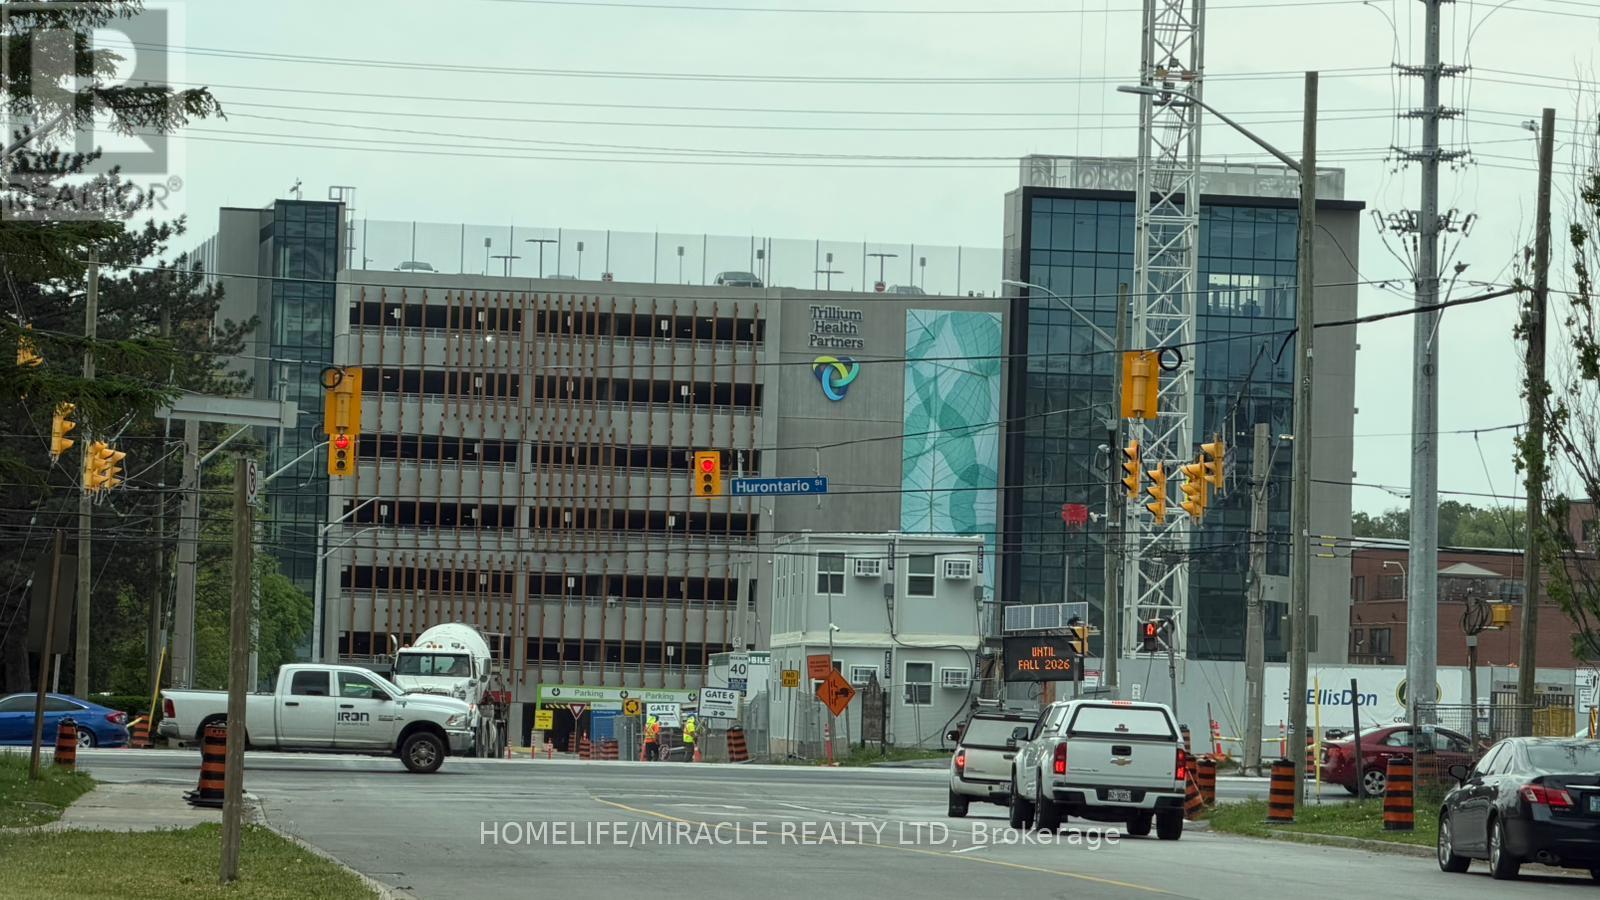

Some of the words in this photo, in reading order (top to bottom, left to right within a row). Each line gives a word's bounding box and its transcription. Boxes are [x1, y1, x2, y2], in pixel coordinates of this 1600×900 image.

[810, 305, 862, 320] Trillium
[815, 320, 858, 333] Health
[810, 334, 864, 348] Partners
[736, 480, 809, 493] Hurontario
[1031, 646, 1056, 657] UNTIL
[730, 663, 747, 675] 40
[1018, 659, 1040, 670] FALL
[1044, 659, 1071, 670] 2026
[574, 689, 605, 699] Parking
[644, 690, 674, 701] Parking
[704, 690, 728, 699] GATE
[728, 692, 735, 700] 6
[1306, 689, 1378, 706] EllisDon
[650, 704, 670, 712] GATE
